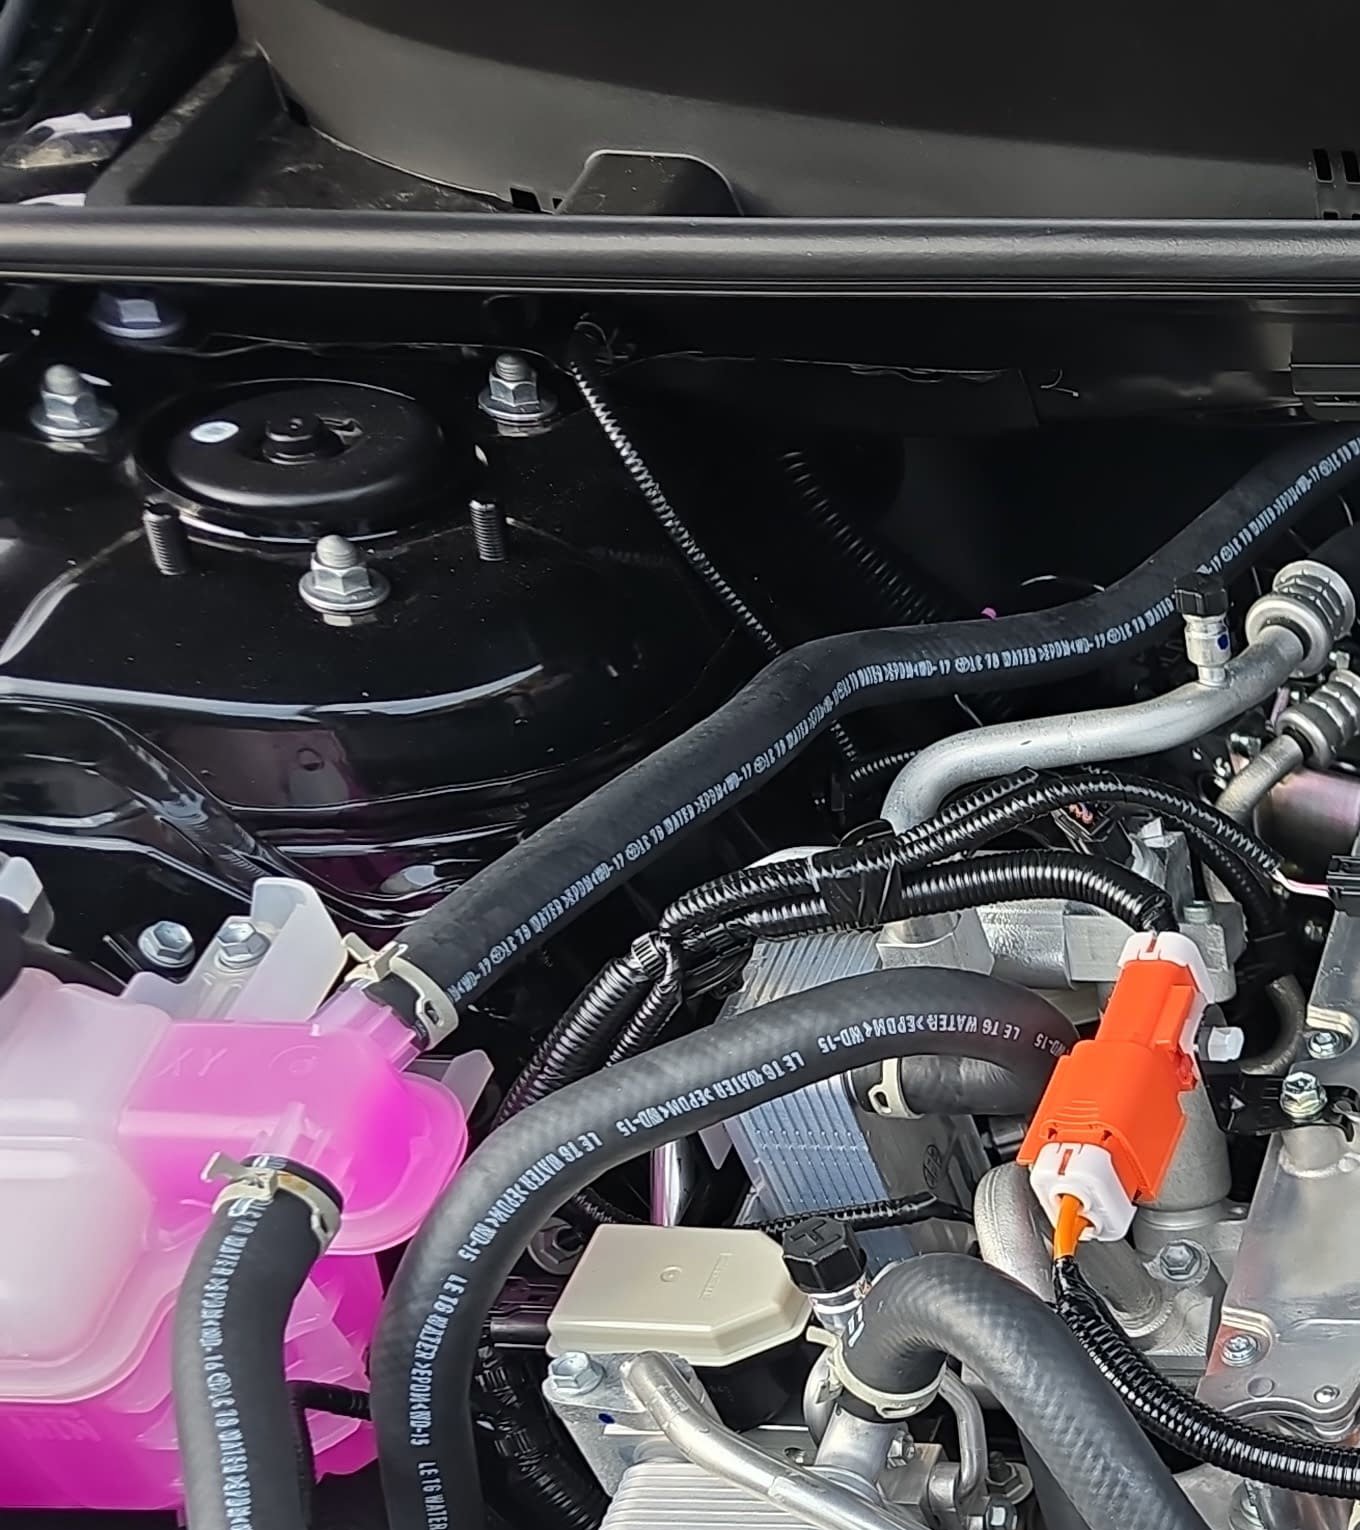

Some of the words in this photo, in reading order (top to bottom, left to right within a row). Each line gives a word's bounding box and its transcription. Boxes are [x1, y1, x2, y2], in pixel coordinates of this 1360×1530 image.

[928, 1012, 978, 1033] WATER
[714, 1069, 765, 1099] WATER
[519, 1153, 566, 1191] WATER
[414, 1313, 449, 1360] WATER
[424, 1494, 449, 1530] WATER
